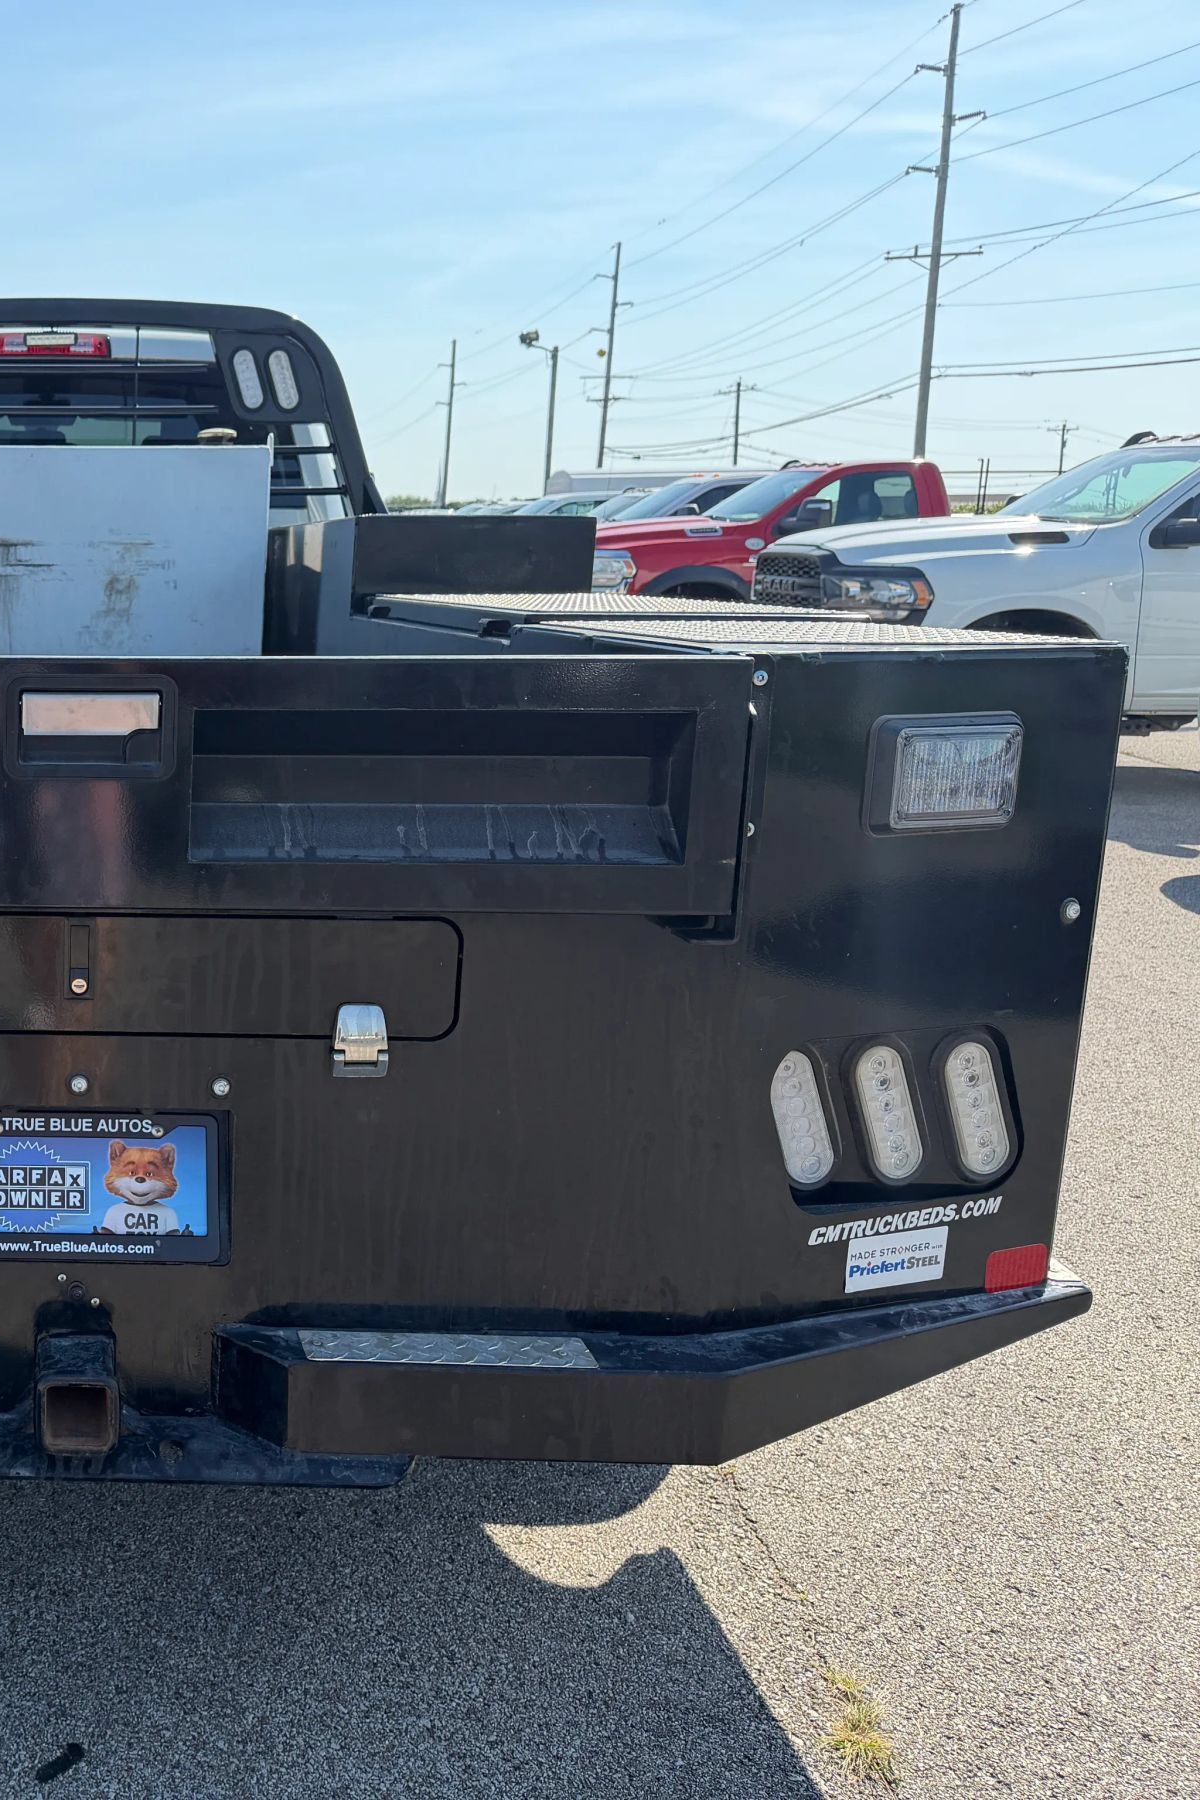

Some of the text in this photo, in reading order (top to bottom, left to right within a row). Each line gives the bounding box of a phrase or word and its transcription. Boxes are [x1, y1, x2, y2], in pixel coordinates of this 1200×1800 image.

[2, 1117, 153, 1134] TRUE BLUE AUTOS
[124, 1212, 159, 1230] CAR
[807, 1195, 1003, 1246] CMTRUCKBEDS.COM
[0, 1240, 155, 1255] www.TrueBlueAutos.com
[850, 1250, 877, 1262] MADE
[879, 1242, 931, 1257] STRONGER
